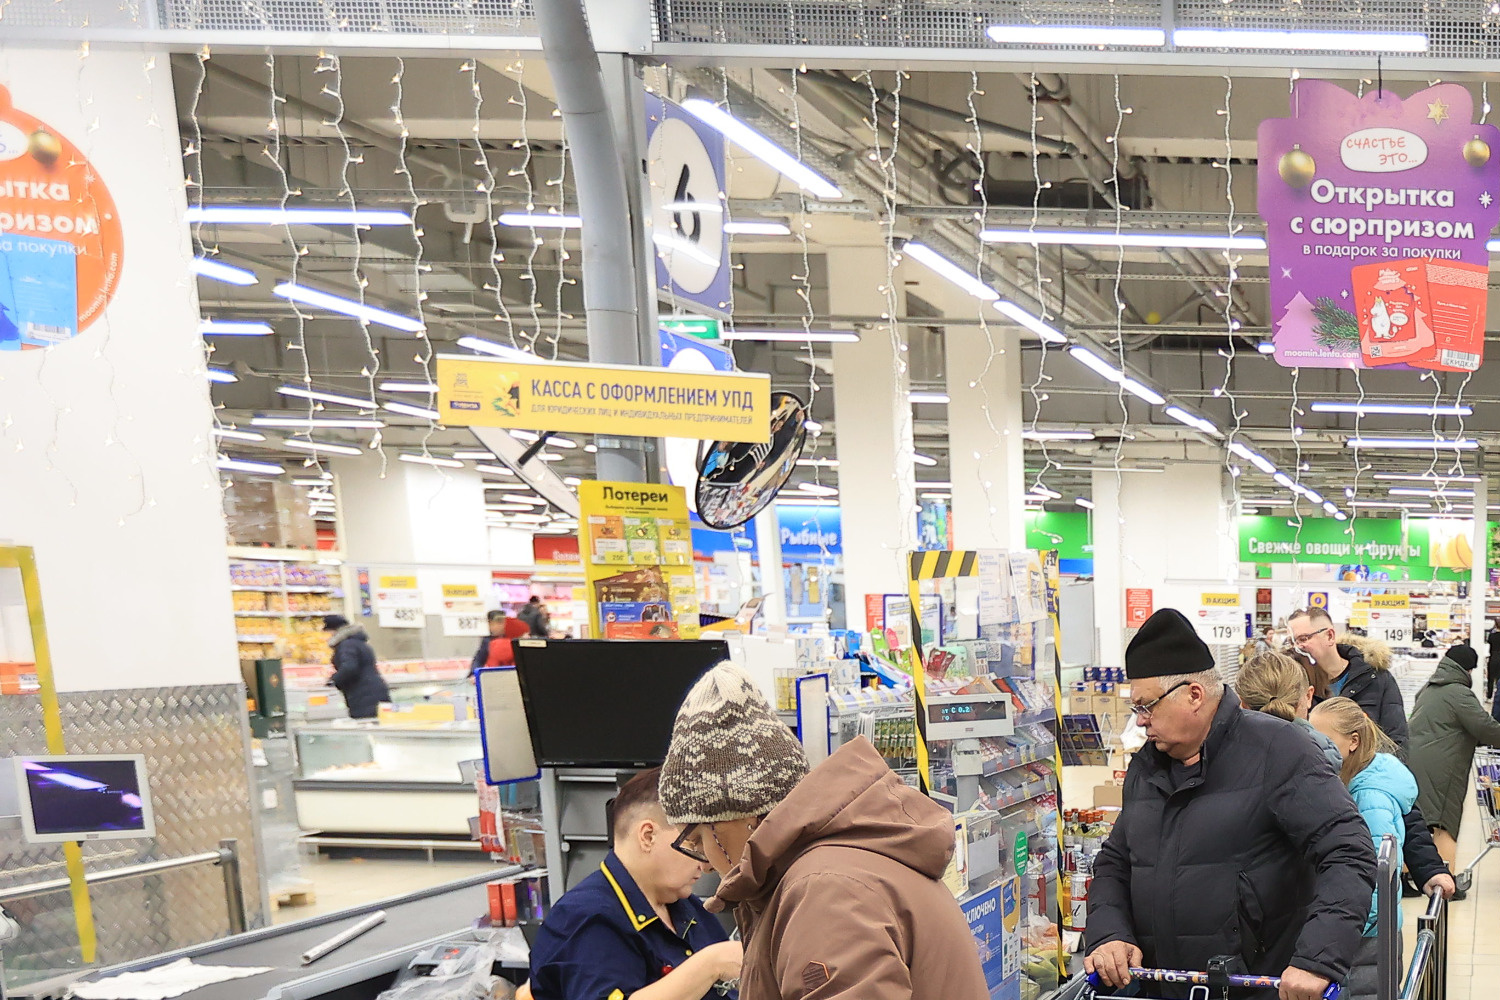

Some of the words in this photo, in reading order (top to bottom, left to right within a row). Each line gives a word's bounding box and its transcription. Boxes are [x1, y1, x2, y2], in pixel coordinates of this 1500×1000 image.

[1346, 137, 1407, 149] СЧАСТЬЕ
[673, 163, 700, 242] 6
[1310, 178, 1455, 212] Открытка
[1289, 216, 1304, 234] с
[1310, 216, 1475, 243] сюрпризом
[17, 240, 88, 257] покупки
[1303, 245, 1311, 255] в
[1315, 245, 1378, 260] подарок
[1381, 246, 1398, 257] за
[1402, 248, 1461, 263] покупки
[1284, 349, 1360, 359] moomin.lenta.com
[531, 379, 582, 399] КАССА
[586, 382, 597, 400] С
[601, 383, 717, 408] ОФОРМЛЕНИЕМ
[722, 390, 754, 411] УПД
[603, 486, 669, 505] Лотереи
[780, 527, 838, 546] Рыбные
[1248, 536, 1301, 555] Свежие
[1306, 540, 1351, 557] овощи
[1213, 626, 1232, 639] 179
[1384, 629, 1403, 642] 149
[963, 897, 996, 924] КЛЮЧЕНО
